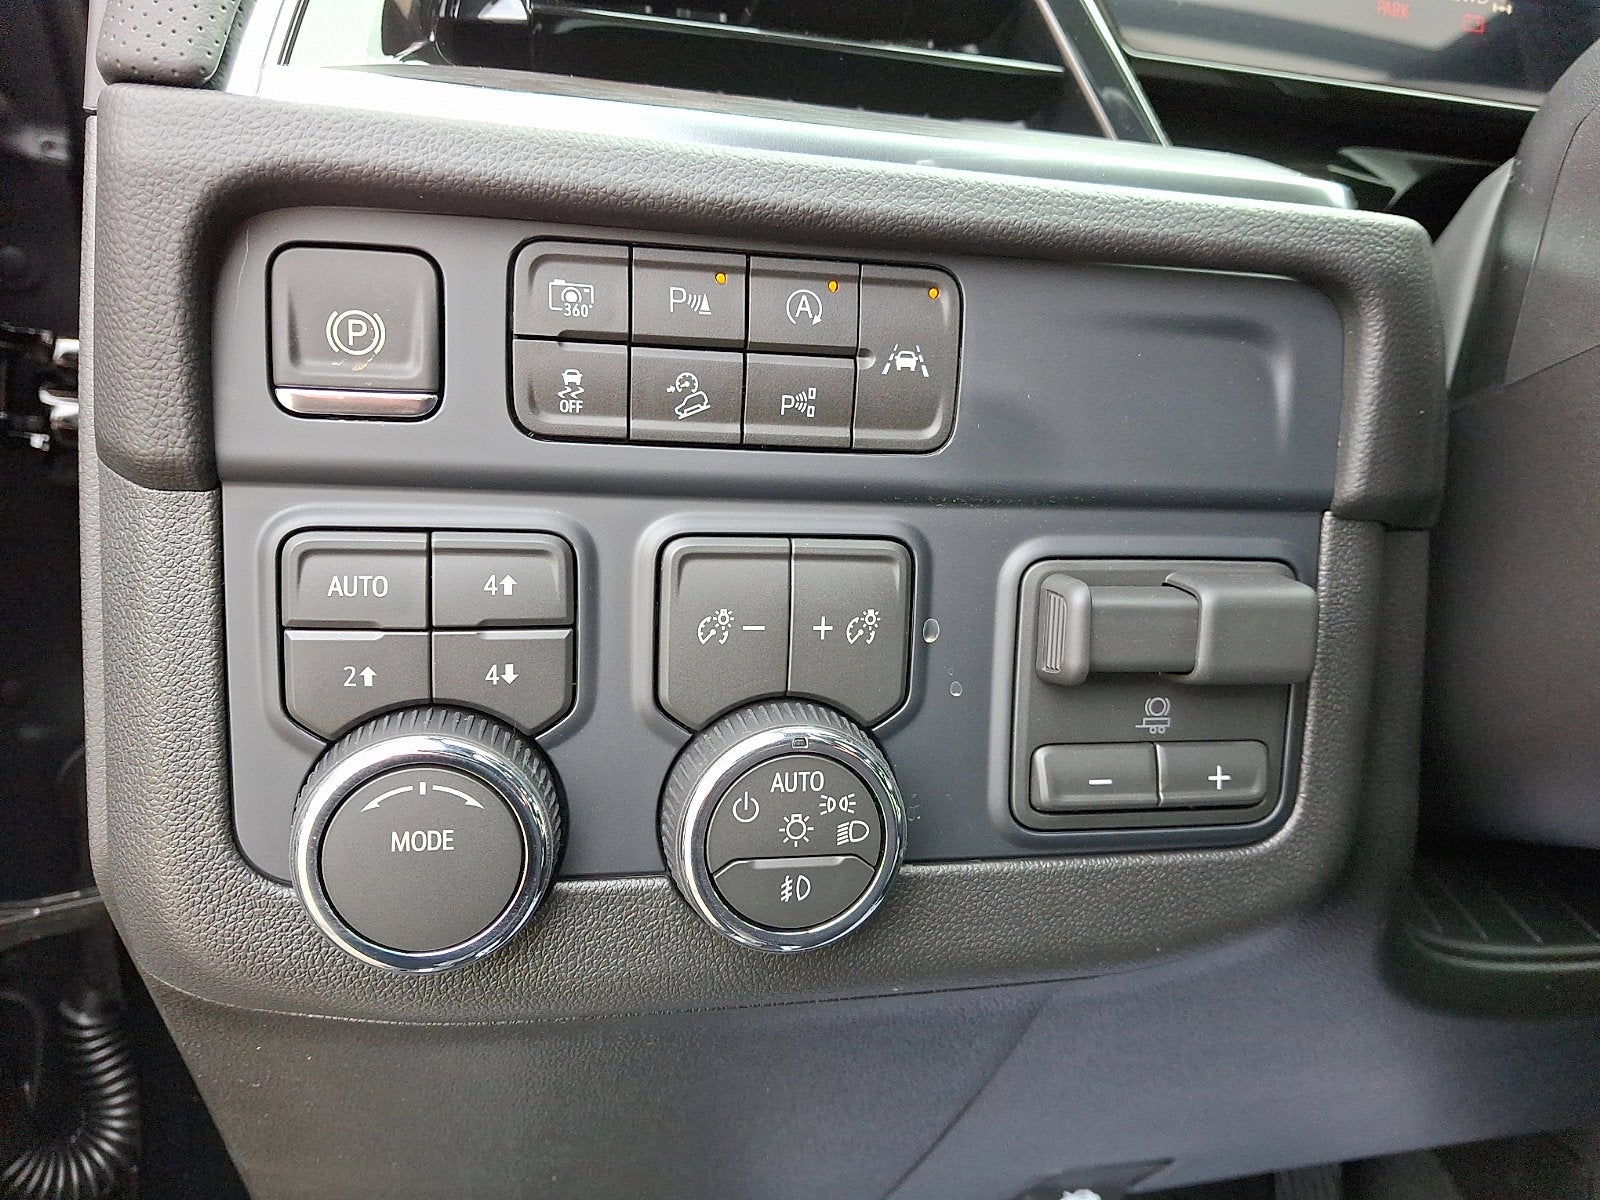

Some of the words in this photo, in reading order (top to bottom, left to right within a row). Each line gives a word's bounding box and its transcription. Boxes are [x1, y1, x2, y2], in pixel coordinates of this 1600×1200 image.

[669, 286, 686, 313] P
[794, 294, 814, 318] A
[347, 318, 368, 346] P
[559, 400, 584, 414] OFF
[780, 393, 796, 416] P
[327, 575, 389, 598] AUTO
[483, 575, 498, 597] 4
[343, 665, 357, 687] 2
[484, 664, 500, 686] 4
[770, 771, 825, 793] AUTO
[390, 830, 455, 853] MODE
